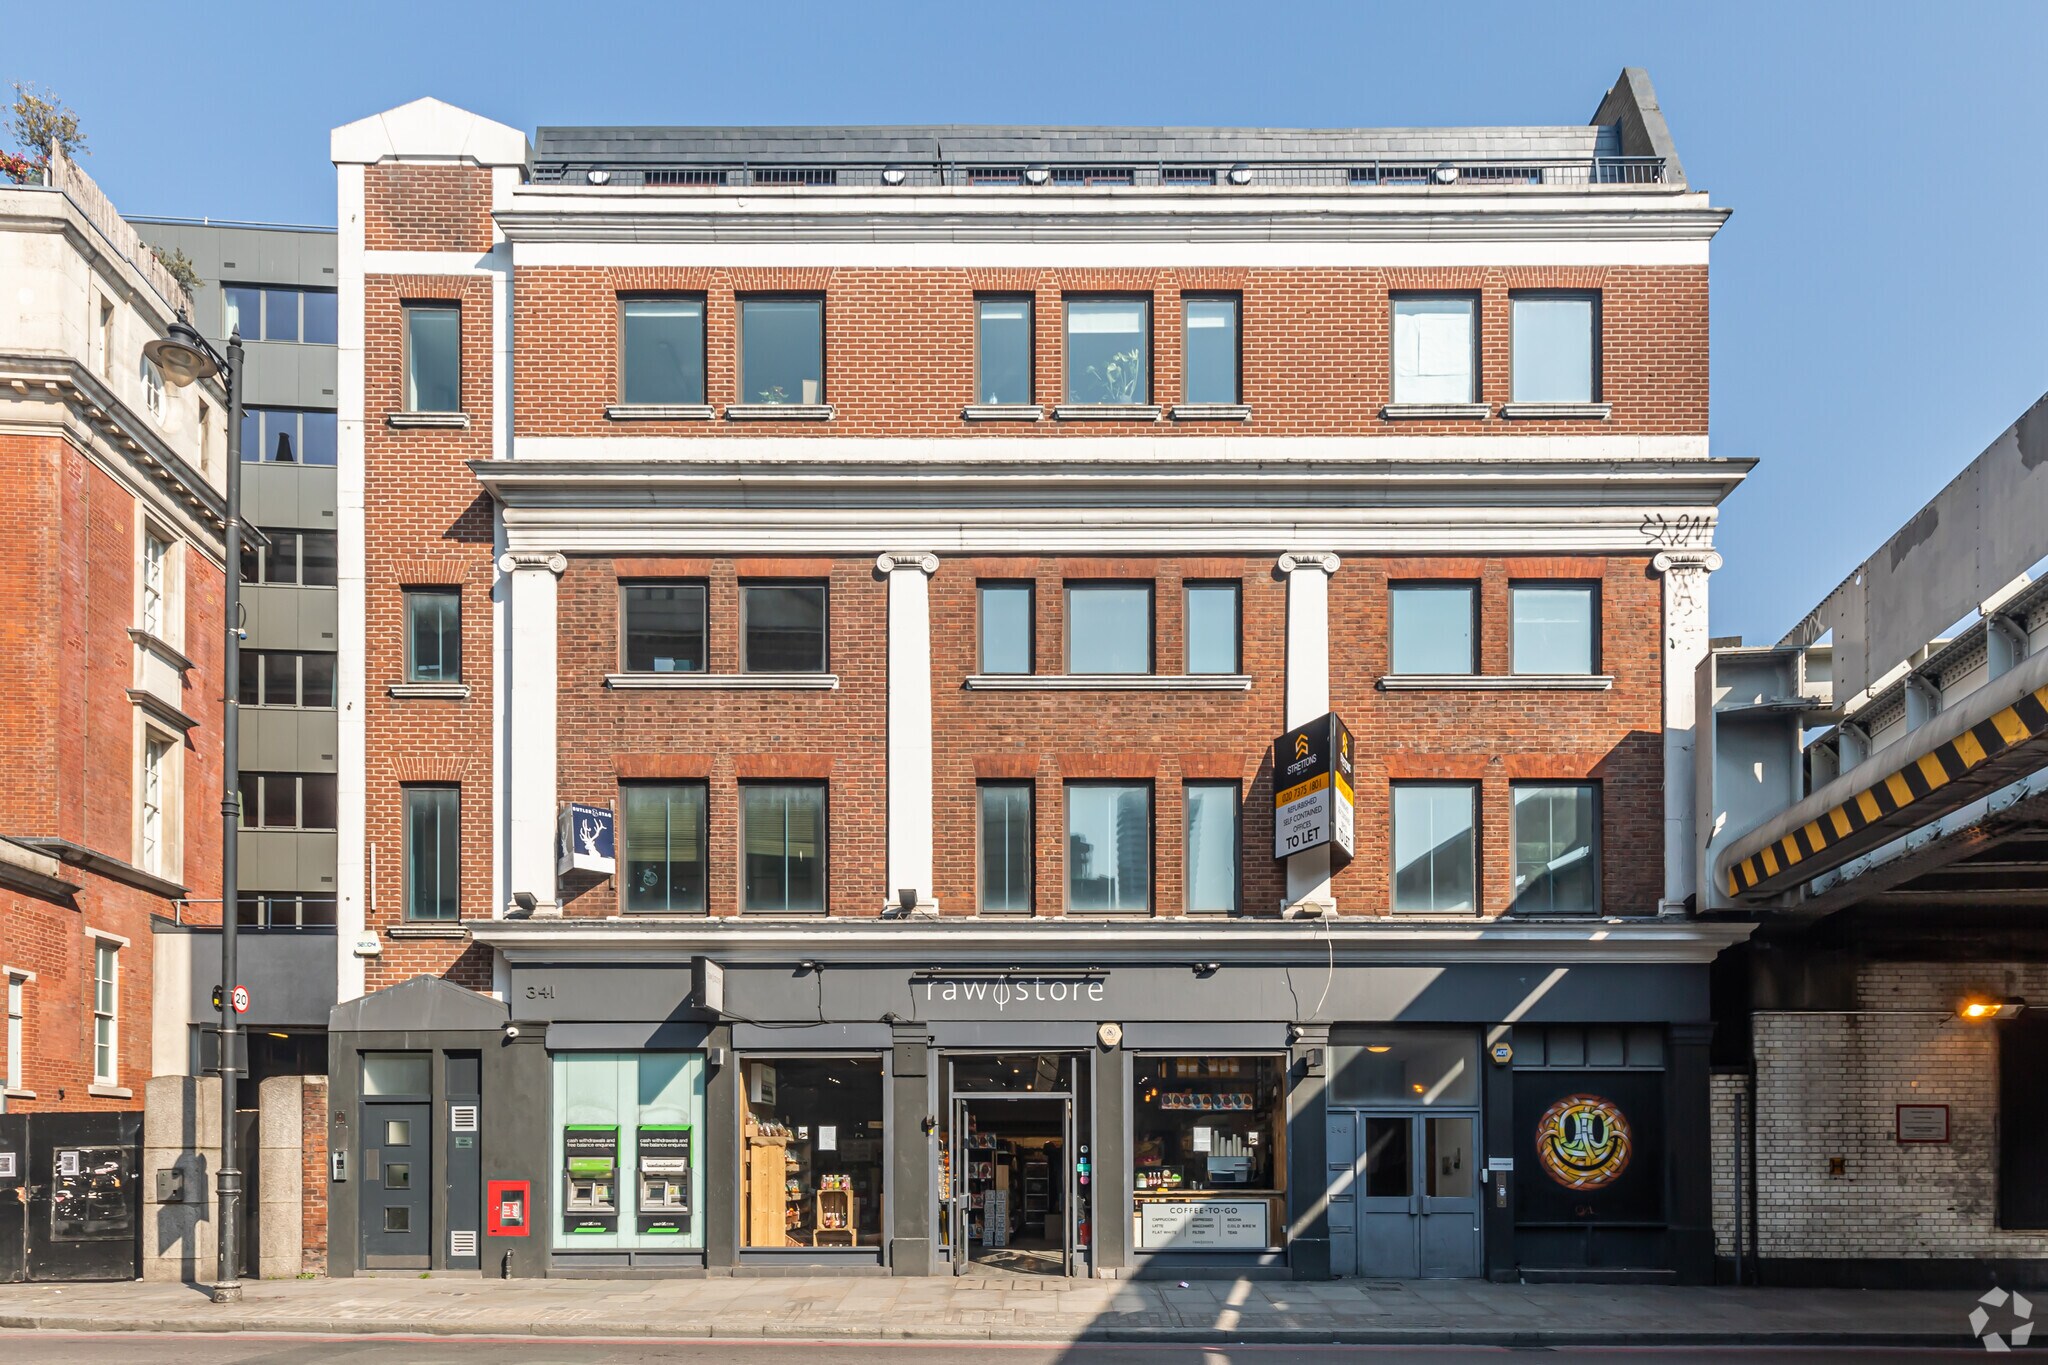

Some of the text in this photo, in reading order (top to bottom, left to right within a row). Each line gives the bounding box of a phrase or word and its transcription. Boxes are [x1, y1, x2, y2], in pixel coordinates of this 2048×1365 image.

[1286, 753, 1317, 775] STRETTONS
[1281, 790, 1292, 803] 020
[1293, 785, 1306, 798] 7375
[1309, 778, 1322, 792] 1801
[572, 806, 592, 815] BUTLER
[1287, 796, 1317, 814] REFURBISHED
[1283, 816, 1293, 827] SELF
[1293, 805, 1323, 823] CONTAINED
[1292, 820, 1312, 833] OFFICES
[1286, 826, 1321, 850] TO LET
[525, 984, 555, 999] 341
[927, 976, 1104, 1001] raw store
[236, 993, 246, 1005] 20
